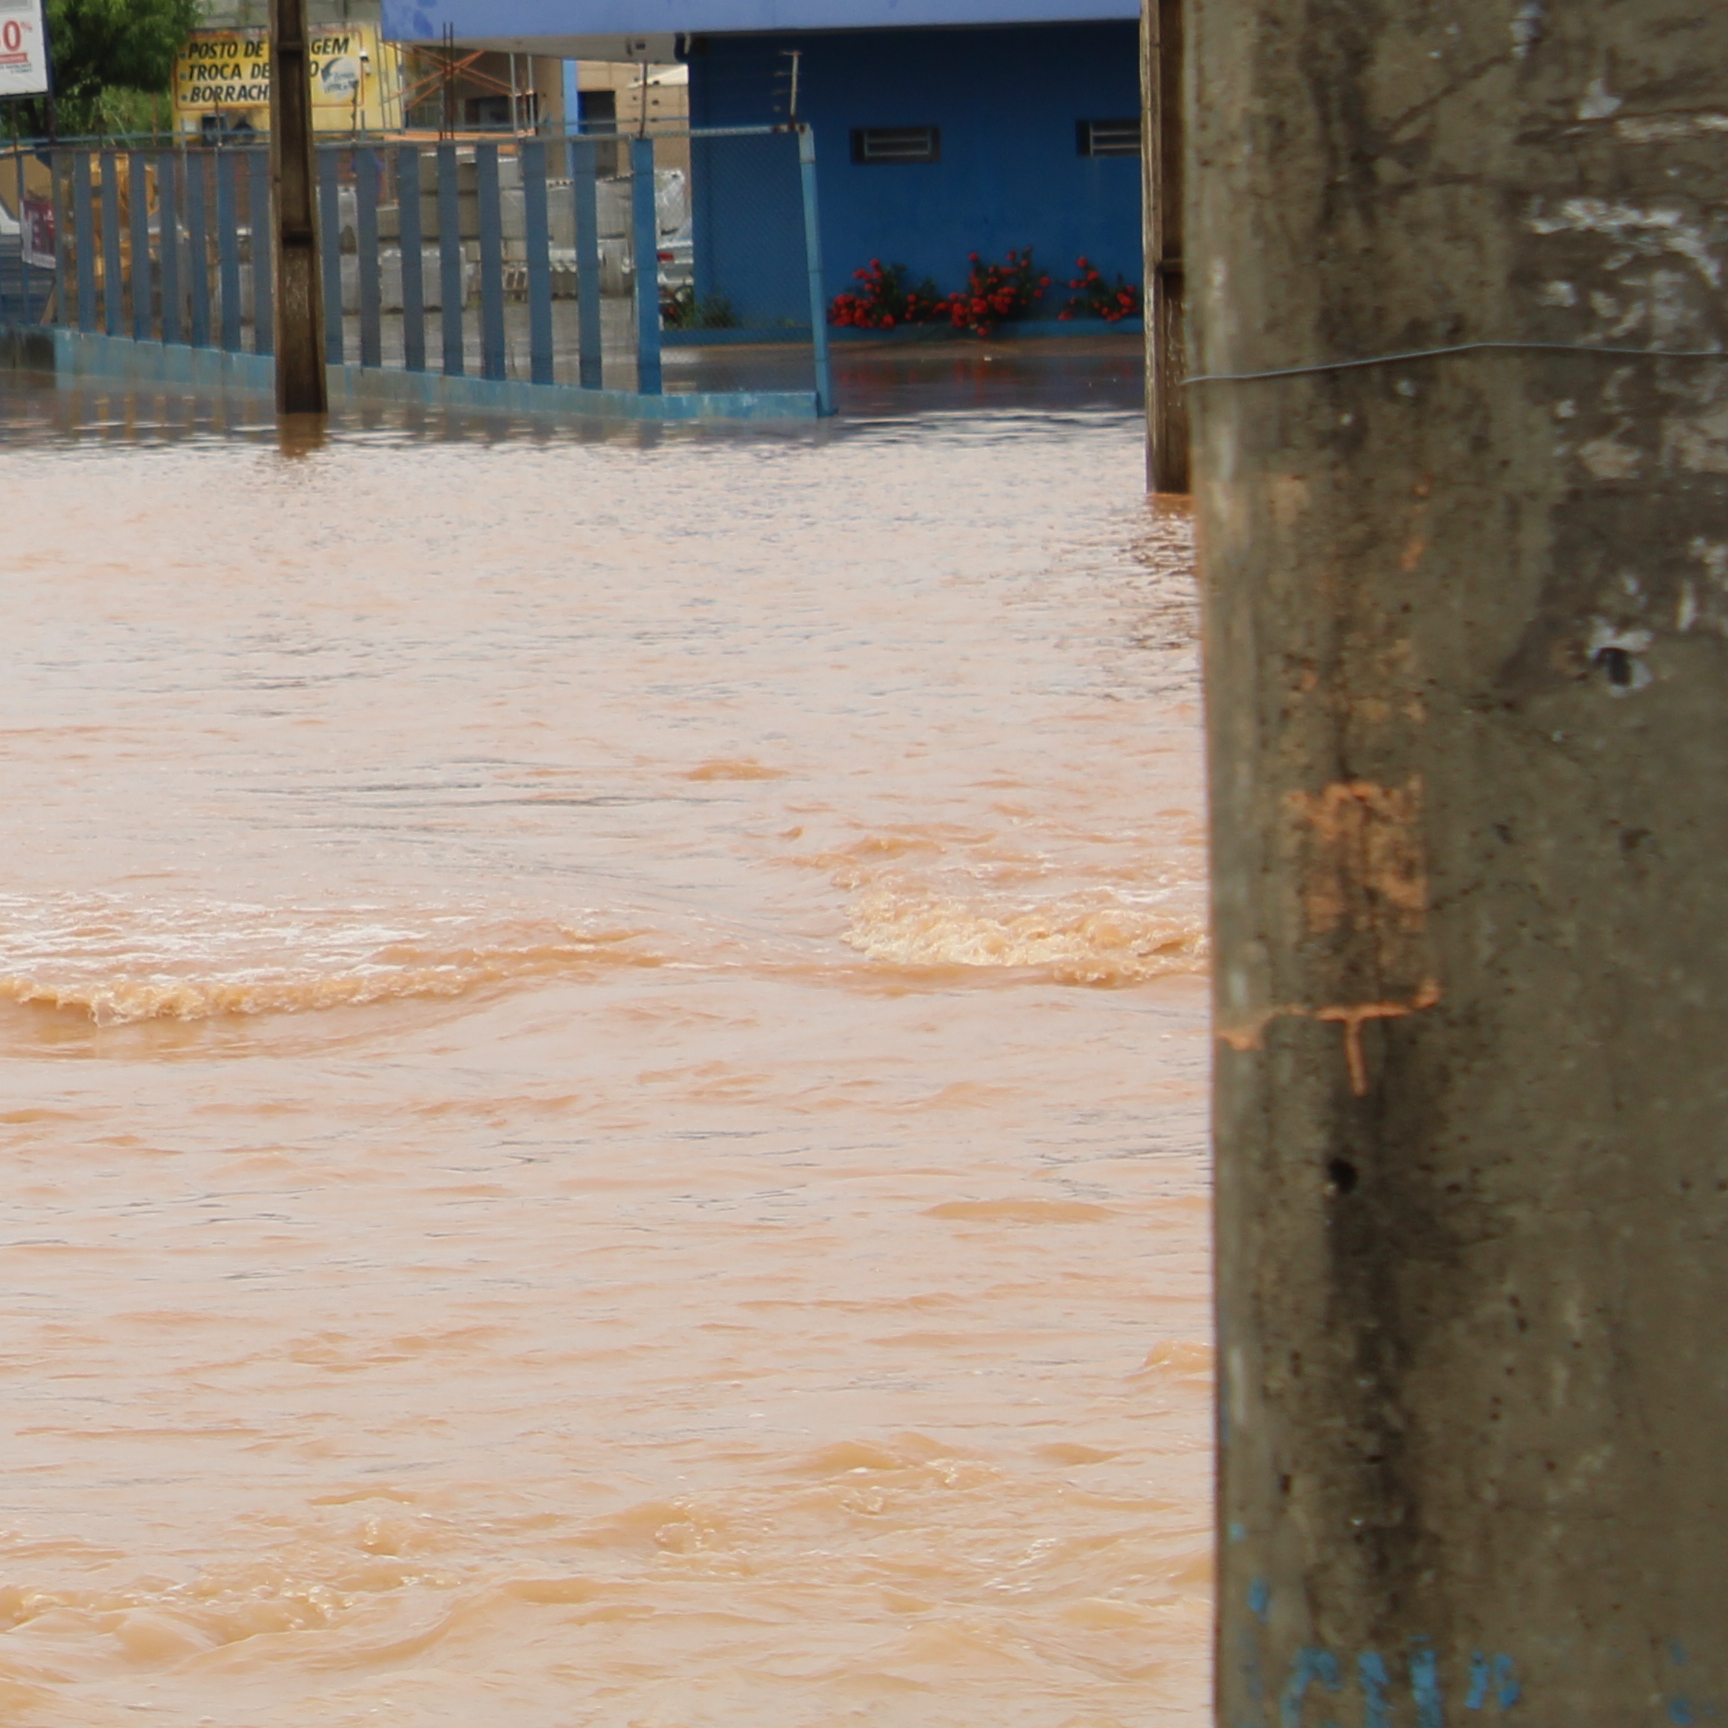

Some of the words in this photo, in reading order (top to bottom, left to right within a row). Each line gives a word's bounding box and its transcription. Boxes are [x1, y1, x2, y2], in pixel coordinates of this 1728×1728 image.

[188, 41, 238, 60] POSTO
[244, 40, 265, 58] DE
[189, 63, 242, 82] TROCA
[250, 62, 270, 80] DE
[189, 83, 270, 103] BORRACH
